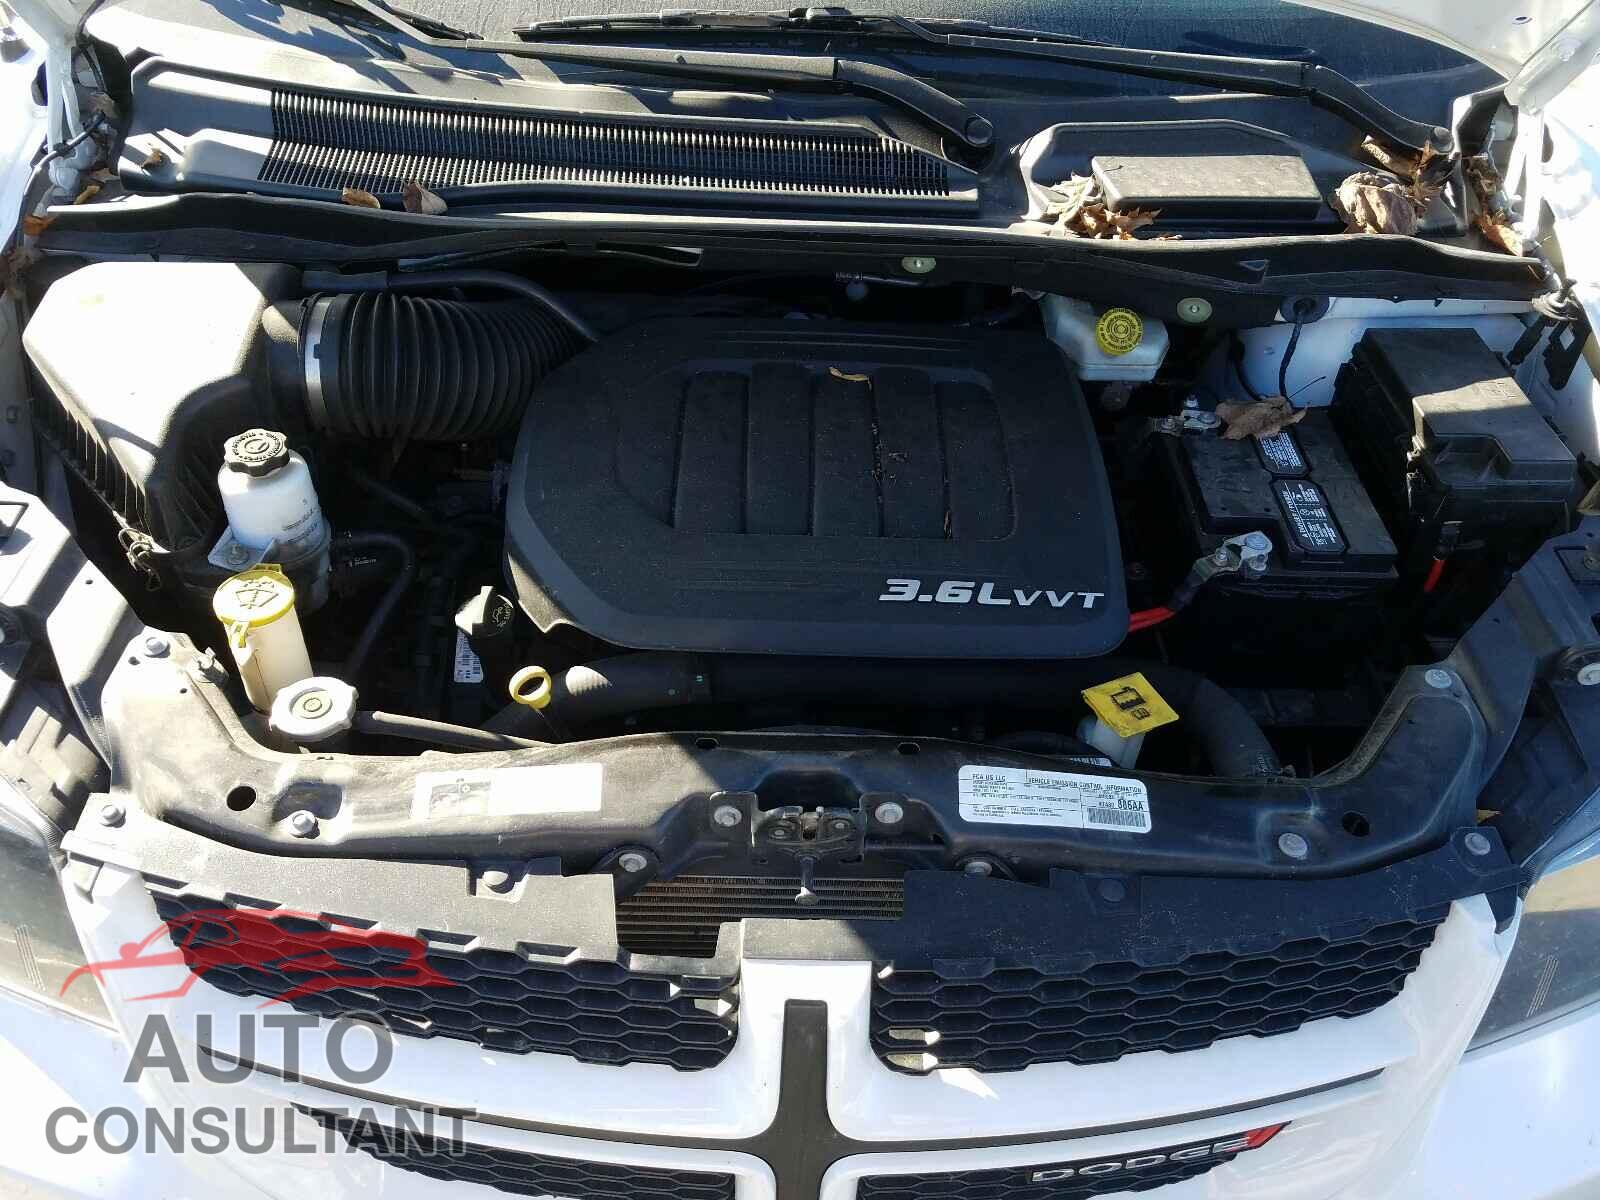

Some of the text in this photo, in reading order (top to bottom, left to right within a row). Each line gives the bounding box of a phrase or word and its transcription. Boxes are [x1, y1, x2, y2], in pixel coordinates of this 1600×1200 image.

[878, 578, 1105, 609] 3.6L VVT
[1028, 777, 1142, 793] VEHICLE EMISSION CONTROL INFORMATION
[1031, 1138, 1249, 1182] DODGE
